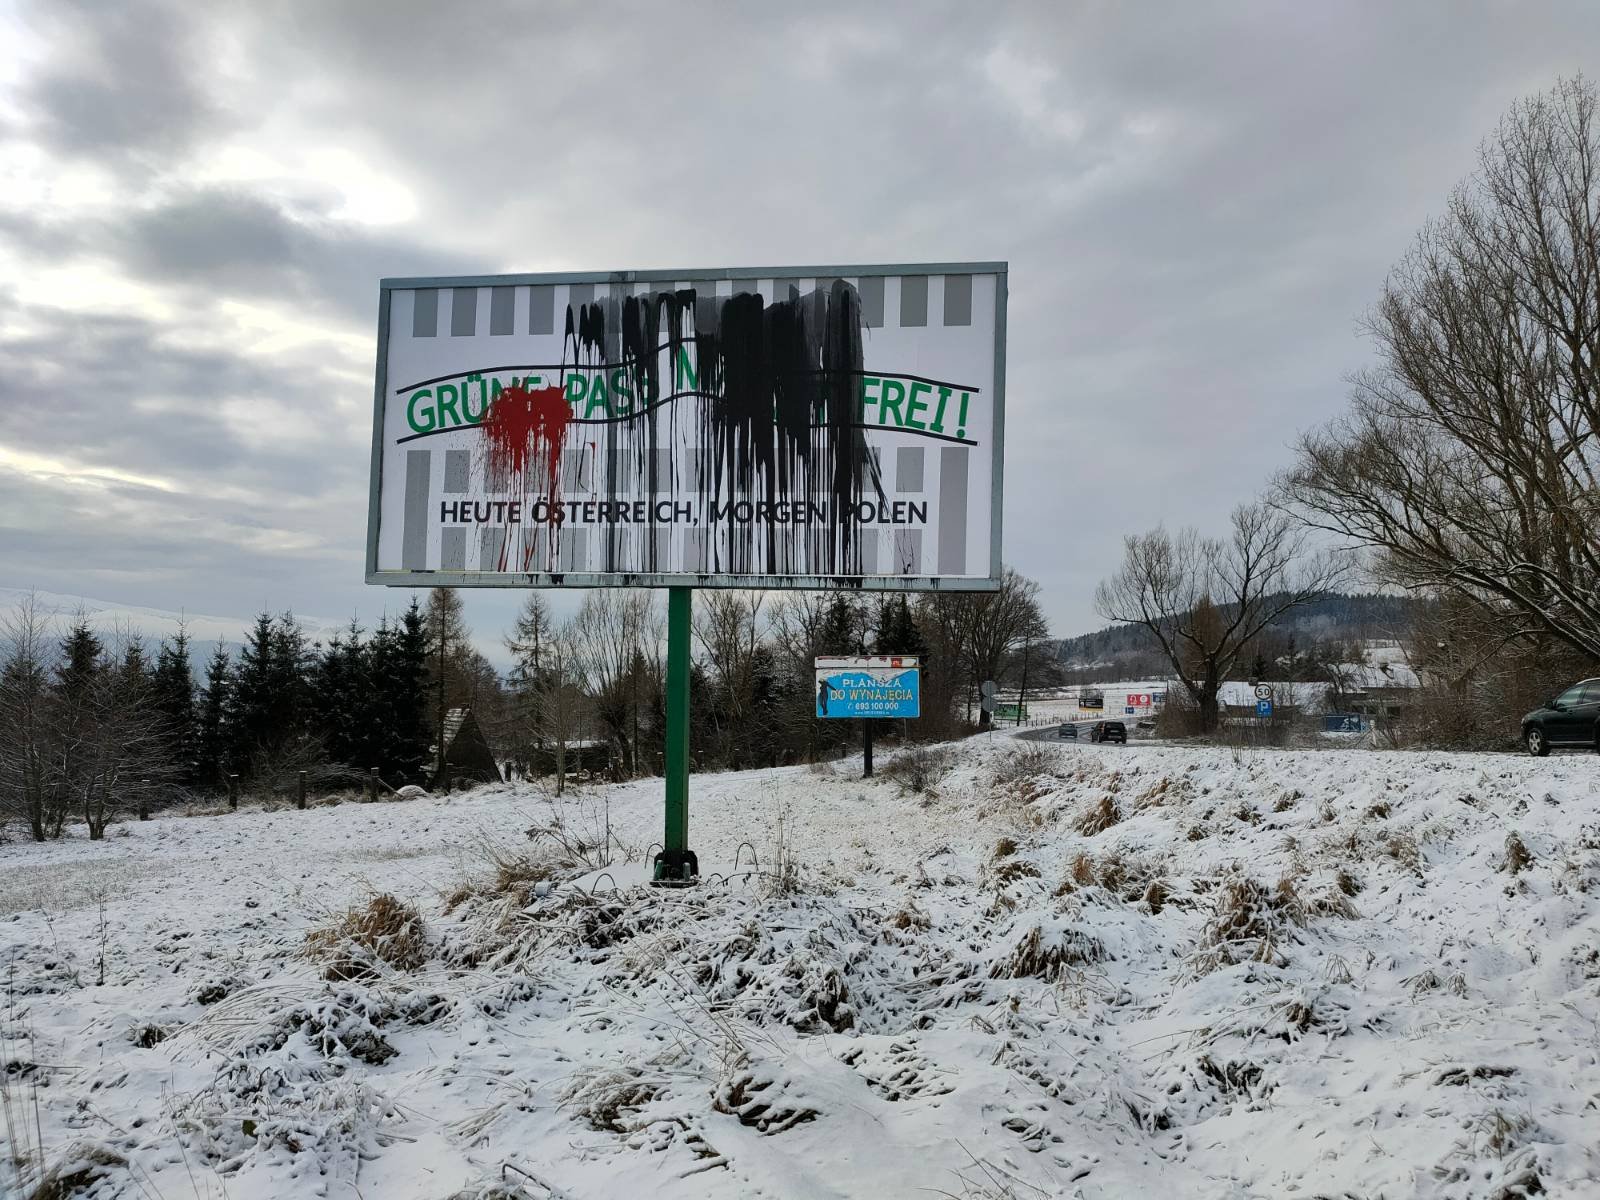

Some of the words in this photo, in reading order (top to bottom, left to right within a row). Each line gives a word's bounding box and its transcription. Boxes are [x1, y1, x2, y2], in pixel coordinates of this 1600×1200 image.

[566, 369, 659, 419] PAS
[861, 377, 971, 439] FREI!
[441, 501, 521, 523] HEUTE
[532, 497, 698, 526] ÖSTERREICH,
[709, 501, 826, 523] MORGEN
[842, 678, 902, 688] PLANSZA
[830, 689, 846, 701] DO
[1257, 688, 1270, 696] 50
[1260, 701, 1269, 712] P
